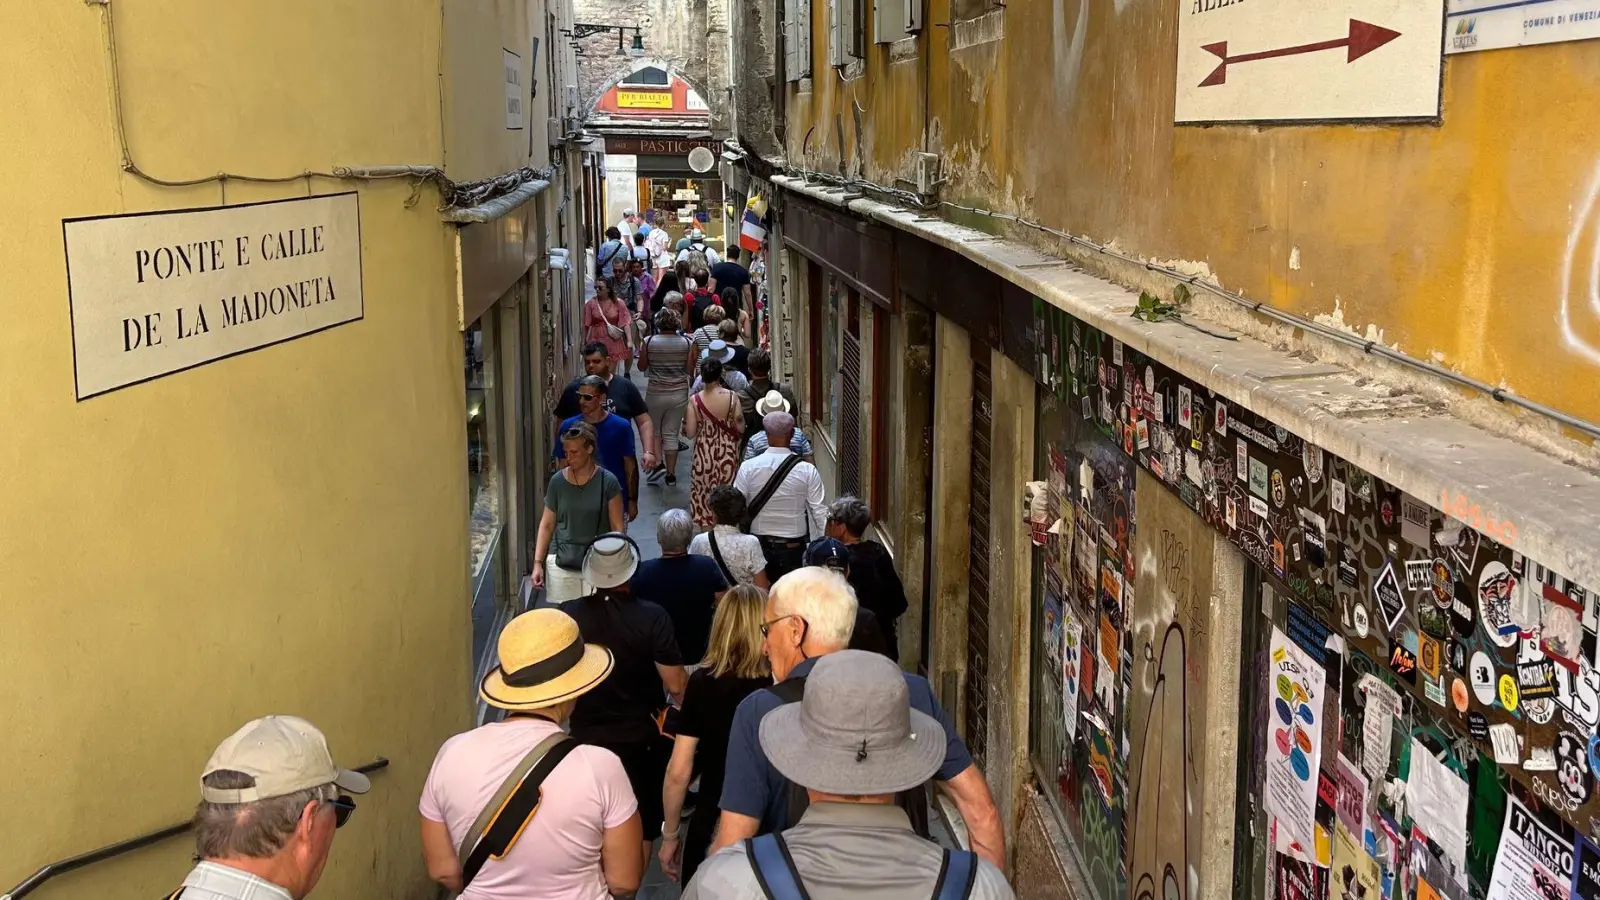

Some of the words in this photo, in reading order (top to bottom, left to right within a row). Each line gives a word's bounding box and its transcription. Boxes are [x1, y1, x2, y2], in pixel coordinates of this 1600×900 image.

[1523, 19, 1554, 28] COMUNE
[1557, 16, 1566, 24] DI
[1452, 34, 1478, 47] VERITAS
[639, 93, 668, 101] RIALTO
[135, 239, 225, 283] PONTE
[236, 236, 250, 266] E
[261, 225, 325, 261] CALLE
[122, 312, 162, 352] DE
[176, 303, 210, 340] LA
[221, 276, 336, 329] MADONETA
[1515, 811, 1574, 875] TANGO
